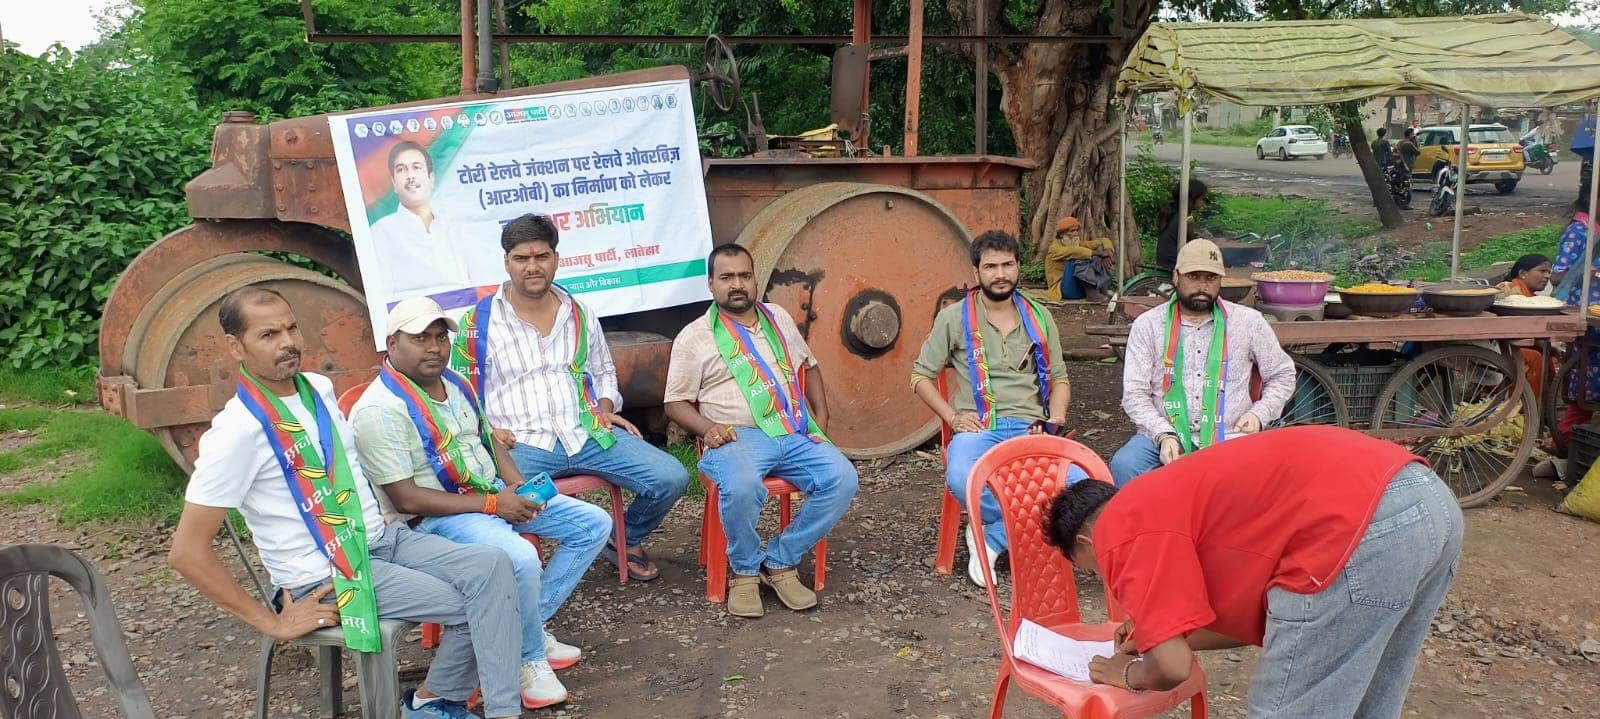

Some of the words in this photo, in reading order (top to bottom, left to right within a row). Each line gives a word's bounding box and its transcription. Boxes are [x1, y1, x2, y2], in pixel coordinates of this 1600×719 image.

[457, 162, 486, 184] टोरी
[488, 159, 521, 180] रेलवे
[523, 158, 570, 176] जंक्शन
[571, 156, 590, 171] पर
[592, 149, 622, 169] रेलवे
[479, 181, 549, 210] (आरओबी)
[551, 183, 570, 197] का
[571, 174, 617, 196] निर्माण
[619, 171, 636, 190] को
[637, 170, 671, 188] लेकर
[575, 203, 645, 228] अभियान
[559, 254, 594, 268] आजसू
[595, 248, 621, 263] पार्टी,
[624, 245, 660, 259] लातेहार
[586, 279, 598, 288] और
[751, 379, 775, 396] AJSU
[341, 615, 370, 635] जसू
